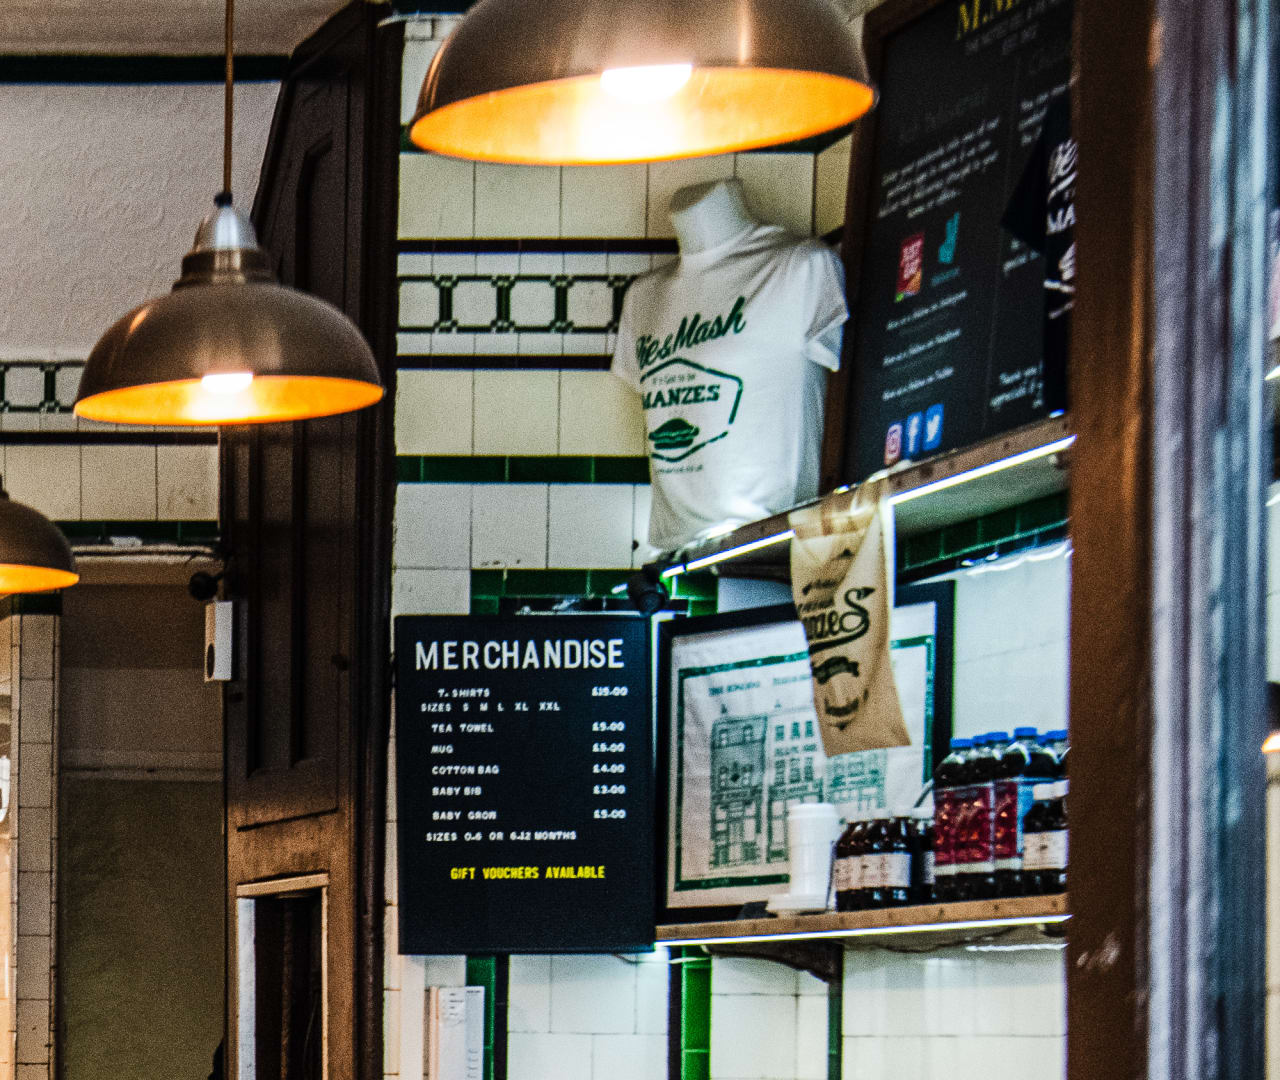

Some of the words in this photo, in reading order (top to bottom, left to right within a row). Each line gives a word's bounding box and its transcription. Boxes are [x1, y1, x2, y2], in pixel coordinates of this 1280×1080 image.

[415, 637, 626, 671] MERCHANDISE
[420, 702, 452, 713] SIZES
[462, 702, 470, 712] S
[479, 701, 489, 712] M
[497, 702, 505, 712] L
[514, 701, 529, 712] XL
[538, 701, 561, 712] XXL
[431, 723, 453, 734] TEA
[459, 722, 494, 733] TOWEL
[430, 744, 454, 754] MUG
[431, 764, 476, 775] COTTON
[477, 764, 500, 775] BAG
[431, 786, 461, 796] BABY
[463, 785, 482, 796] BIB
[432, 810, 462, 821] BABY
[467, 810, 498, 821] GROW
[426, 831, 458, 842] SIZES
[488, 831, 505, 841] OR
[533, 830, 577, 841] MONTHS
[450, 866, 476, 880] GIFT
[482, 866, 540, 880] VOUCHERS
[545, 865, 606, 879] AVAILABLE
